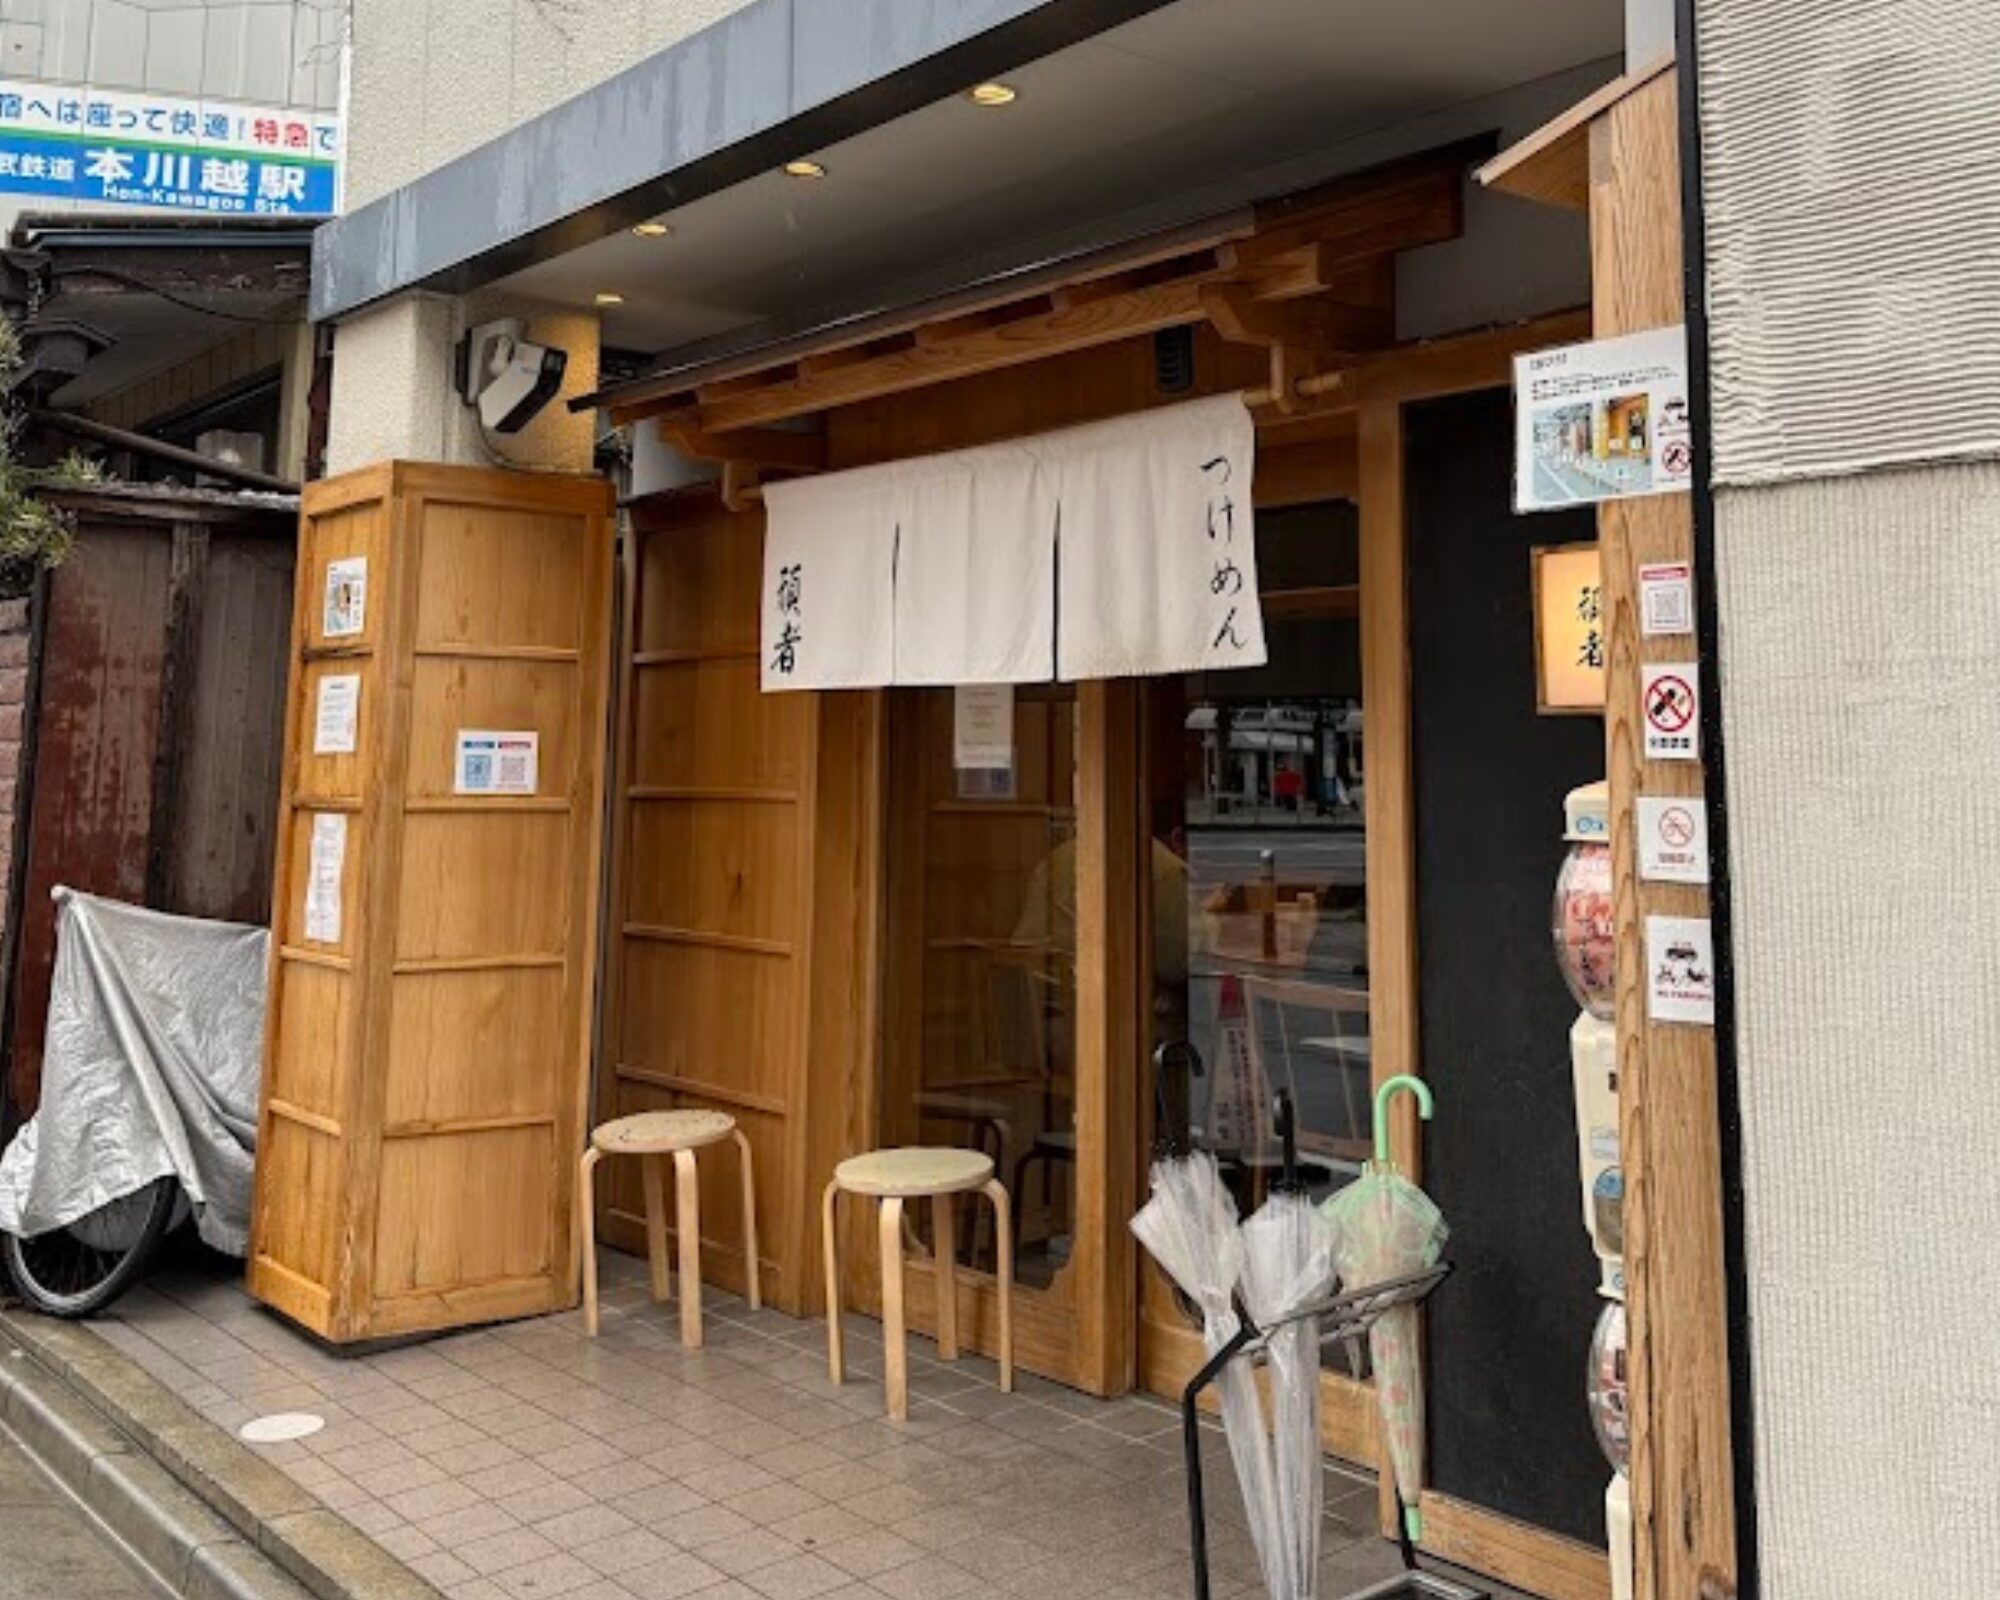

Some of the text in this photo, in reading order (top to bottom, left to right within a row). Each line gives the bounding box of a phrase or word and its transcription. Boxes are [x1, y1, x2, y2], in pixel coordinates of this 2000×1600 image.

[84, 147, 306, 200] 本川越駅
[102, 183, 246, 212] Hon-Kawagoe
[1201, 455, 1249, 651] つけめん
